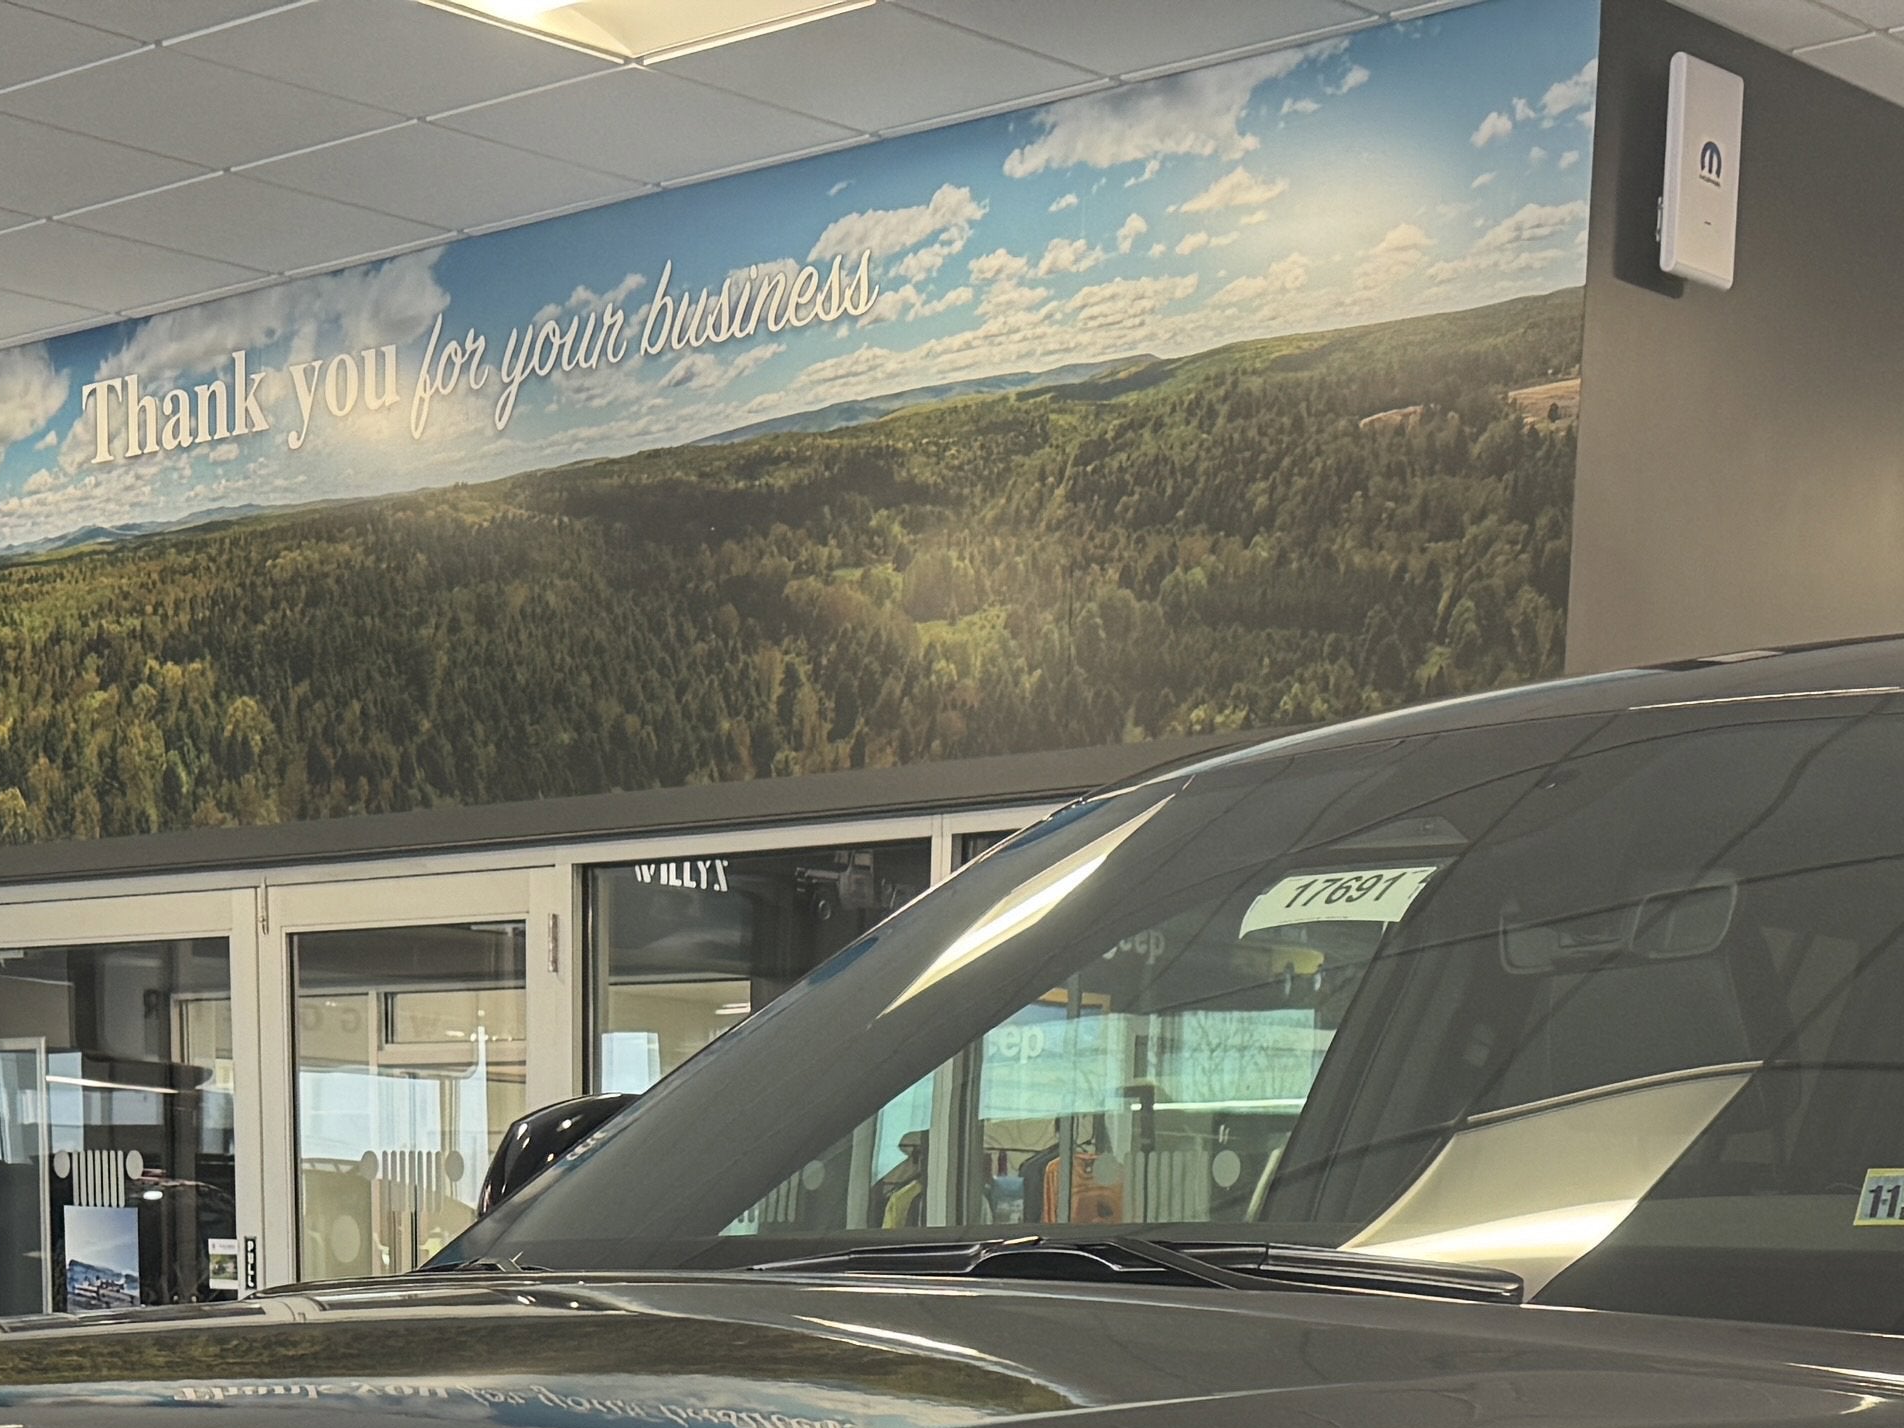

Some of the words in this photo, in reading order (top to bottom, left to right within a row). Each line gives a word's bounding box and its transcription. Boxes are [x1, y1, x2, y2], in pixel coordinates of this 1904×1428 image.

[81, 352, 269, 464] Thank
[287, 344, 398, 449] you
[409, 313, 490, 440] for
[496, 302, 627, 432] your
[641, 248, 880, 355] business
[634, 859, 729, 892] WILLYS
[1284, 871, 1406, 909] 17691
[1868, 1184, 1901, 1218] 11
[247, 1240, 255, 1288] PULL
